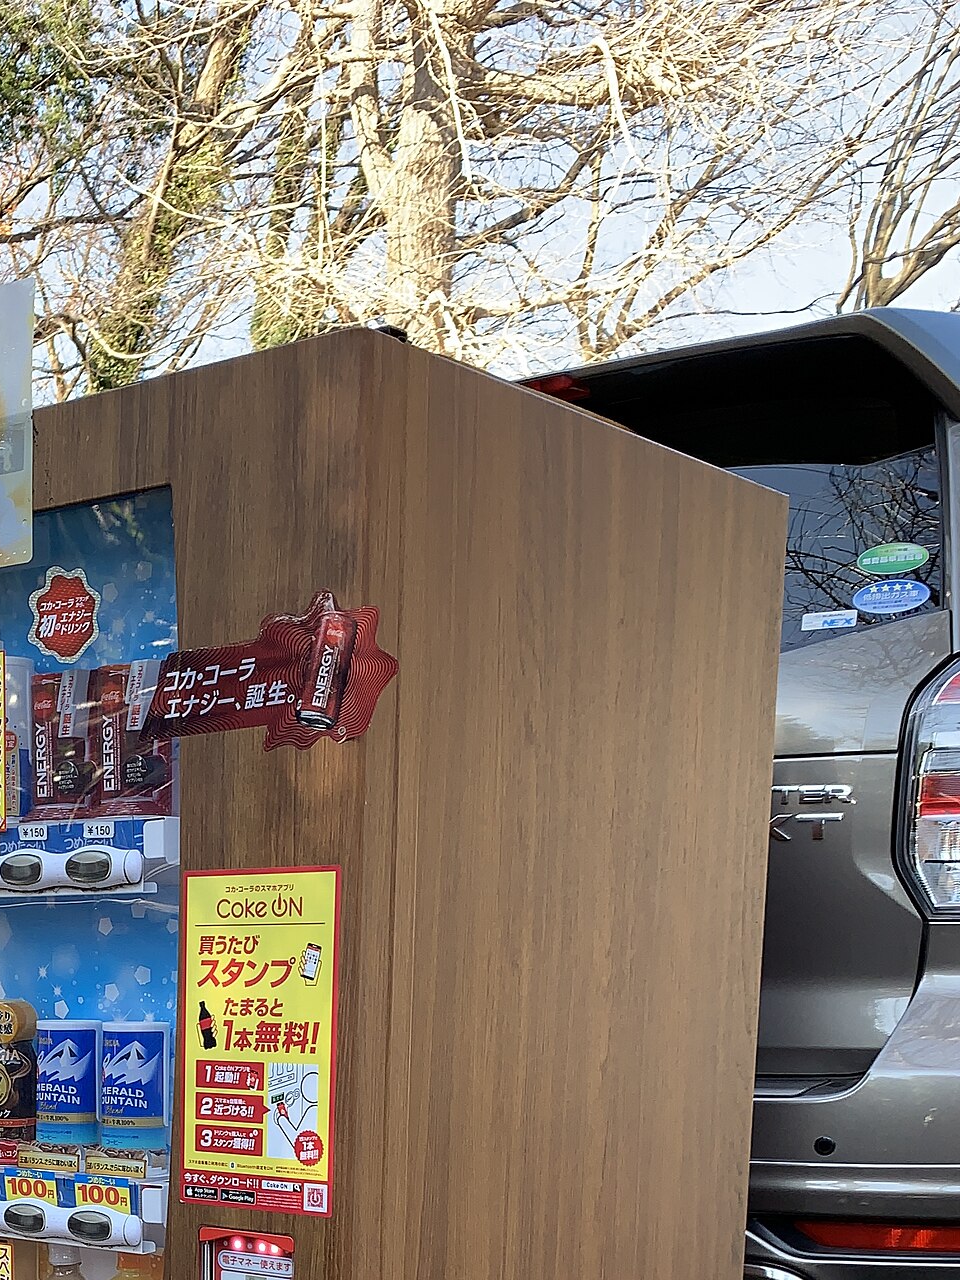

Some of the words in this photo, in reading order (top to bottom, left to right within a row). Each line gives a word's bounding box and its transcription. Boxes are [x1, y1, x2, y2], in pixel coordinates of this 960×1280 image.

[40, 598, 74, 611] コカ・コーラ
[60, 609, 92, 622] エナジー
[60, 621, 91, 635] ドリンク
[164, 657, 257, 691] コカ・コーラ
[312, 644, 334, 708] ENERGY
[164, 680, 295, 720] エナジー、誕生。
[36, 722, 48, 798] ENERGY
[102, 714, 114, 792] ENERGY
[22, 827, 45, 838] ¥150
[87, 825, 111, 836] ¥150
[225, 884, 294, 893] コカ・コーラのスマホアプリ
[216, 898, 268, 918] Coke
[198, 935, 260, 955] 買うたび
[197, 956, 296, 988] スタンプ
[223, 997, 284, 1017] たまると
[223, 1020, 320, 1054] 1本無料!
[205, 1065, 212, 1083] 1
[214, 1071, 240, 1084] 起動!!
[200, 1097, 213, 1115] 2
[213, 1104, 255, 1118] 近づける!!
[200, 1129, 213, 1147] 3
[213, 1138, 256, 1151] スタンプ獲得!!
[303, 1142, 315, 1151] 1本
[7, 1178, 55, 1199] 100円
[184, 1172, 259, 1189] 今すぐ、ダウンロード!!
[78, 1184, 128, 1207] 100円
[222, 1255, 291, 1272] 電子マネー使えます
